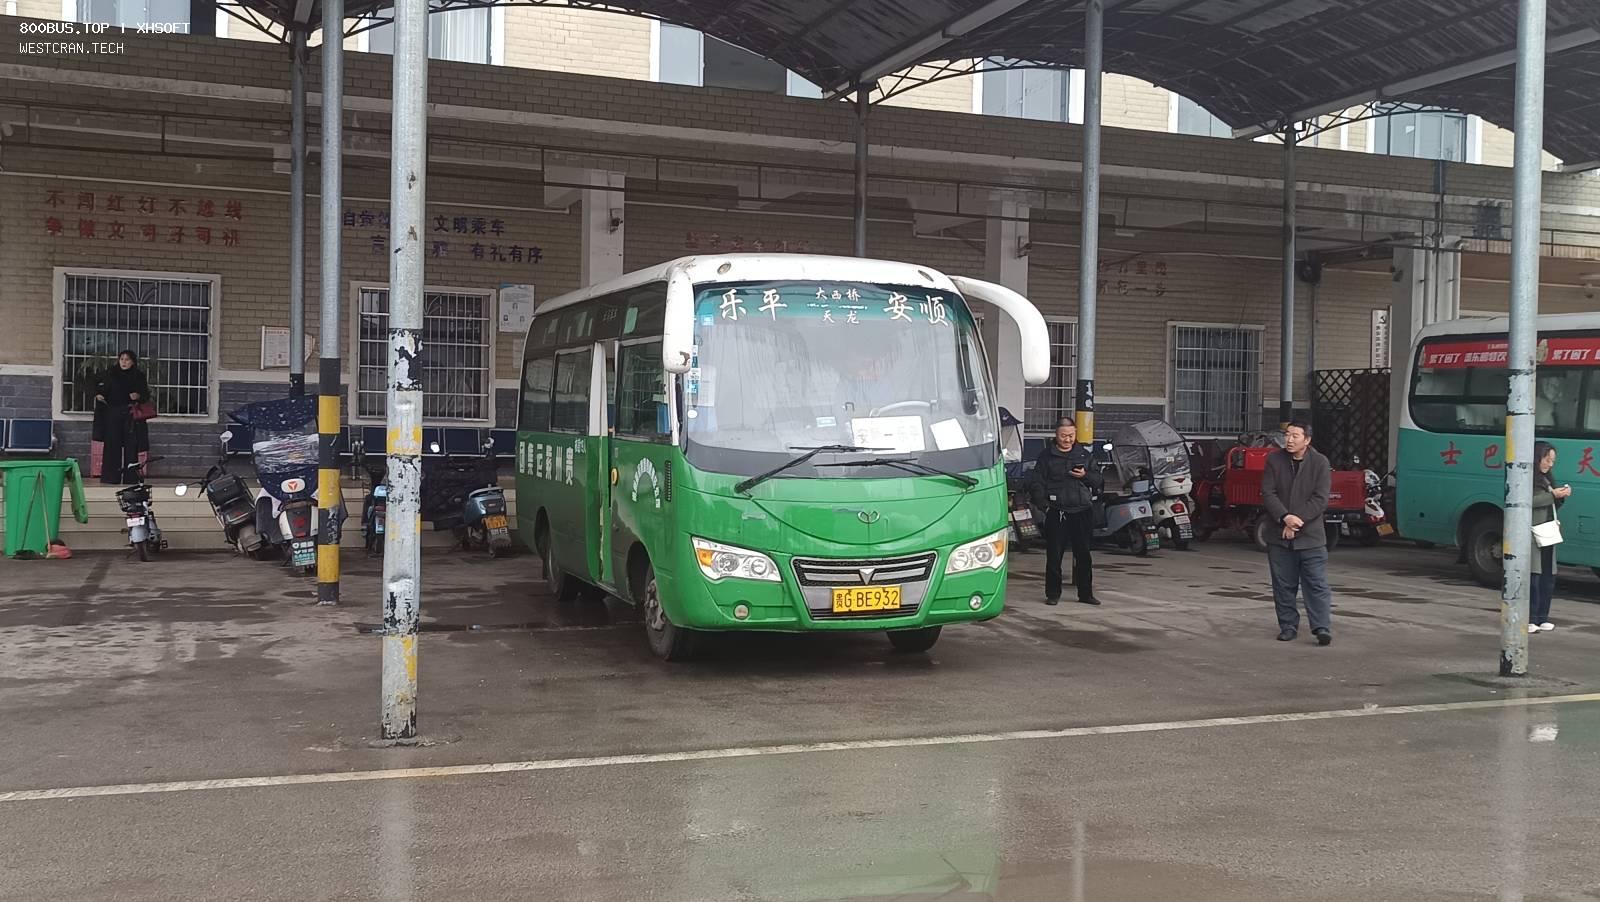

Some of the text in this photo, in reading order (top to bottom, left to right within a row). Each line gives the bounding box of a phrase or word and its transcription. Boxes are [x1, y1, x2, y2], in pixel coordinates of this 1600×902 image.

[46, 189, 242, 221] 不闯红灯不越线
[433, 215, 505, 237] 文明乘车
[469, 241, 544, 264] 有礼有序
[815, 287, 862, 302] 大西桥
[719, 288, 949, 327] 乐平 安顺
[822, 310, 860, 325] 天龙
